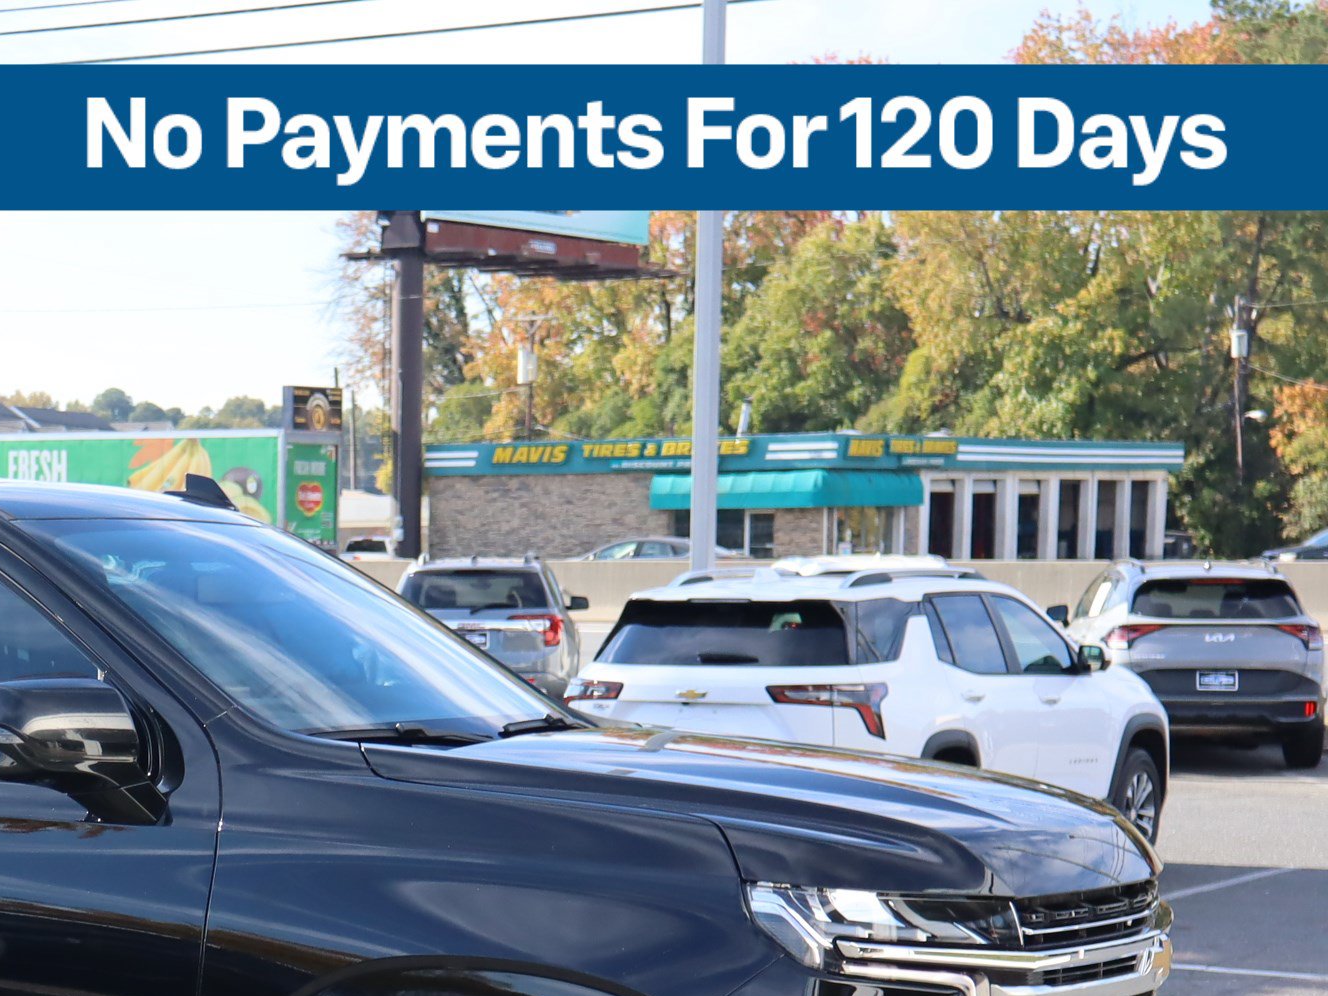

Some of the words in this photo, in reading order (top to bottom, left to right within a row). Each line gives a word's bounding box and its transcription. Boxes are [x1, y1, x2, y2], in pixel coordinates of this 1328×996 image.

[8, 450, 67, 482] FRESH
[491, 444, 570, 465] MAVIS
[582, 442, 642, 458] TIRES
[644, 442, 657, 457] &
